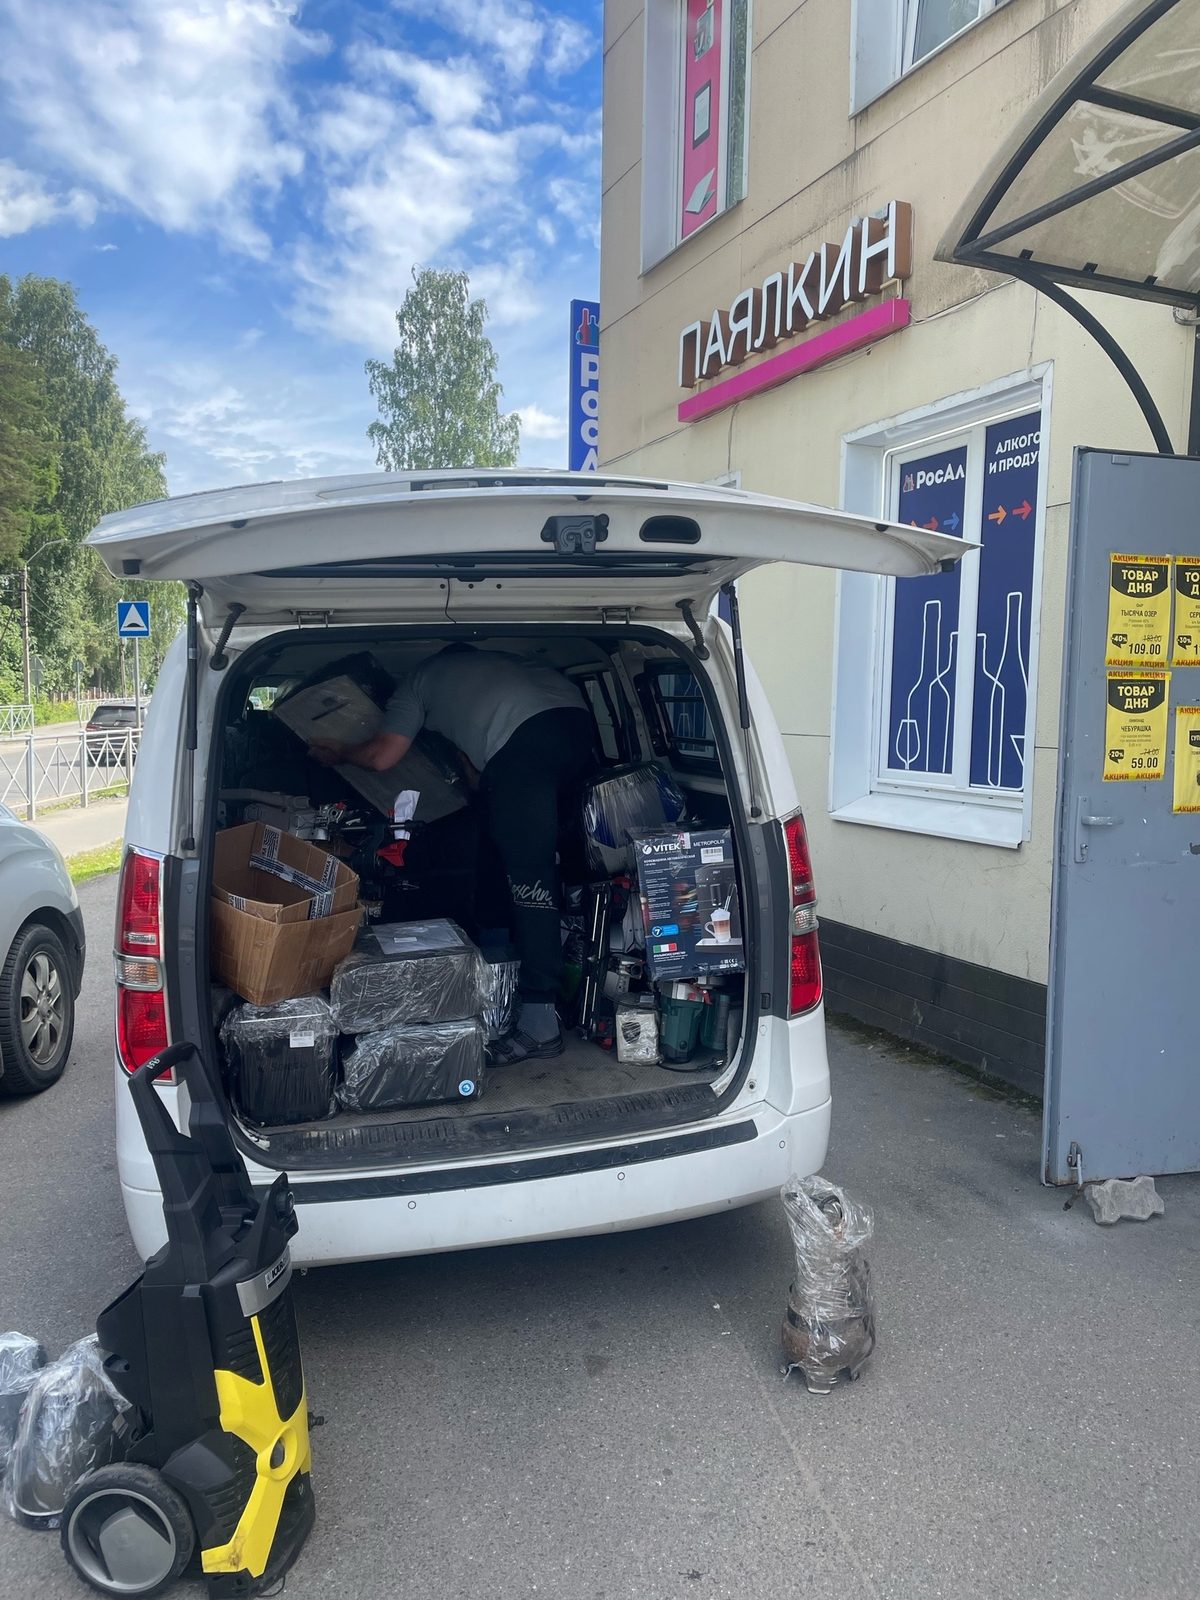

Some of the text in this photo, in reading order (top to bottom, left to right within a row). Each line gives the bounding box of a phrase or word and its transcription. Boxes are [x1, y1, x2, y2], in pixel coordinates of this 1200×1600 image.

[678, 199, 900, 387] ПАЯЛКИН
[988, 450, 1040, 475] И ПРОДУ
[916, 463, 965, 489] РосАл
[1113, 554, 1170, 564] АКЦИЯ АКЦИЯ
[1121, 569, 1159, 582] ТОВАР
[1127, 582, 1153, 594] ДНЯ
[1129, 643, 1161, 655] 109.00
[1107, 658, 1165, 668] АКЦИЯ АКЦИЯ
[1140, 671, 1166, 679] АКЦИЯ
[1117, 685, 1155, 697] ТОВАР
[1124, 698, 1149, 709] ДНЯ
[1131, 757, 1158, 769] 59.00
[1135, 772, 1161, 780] АКЦИЯ
[653, 843, 681, 852] VITEK
[693, 839, 725, 847] METROPOLIS
